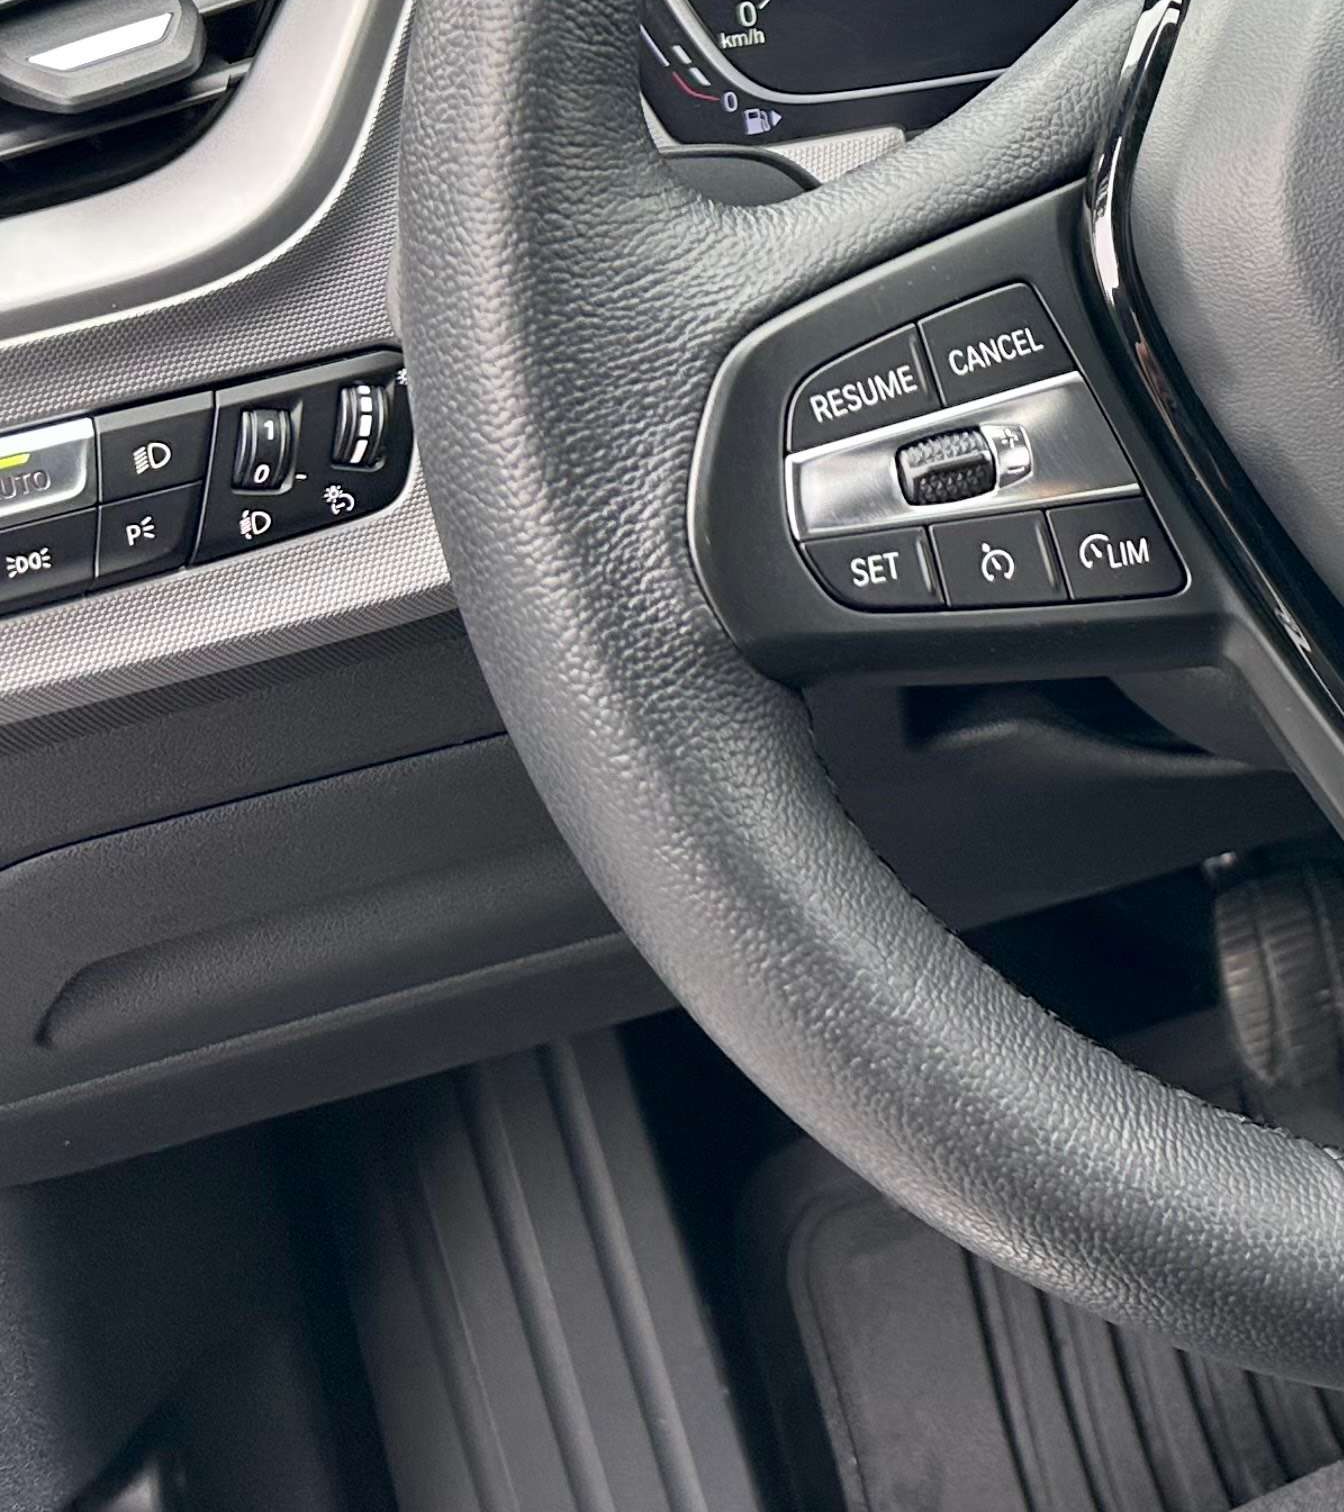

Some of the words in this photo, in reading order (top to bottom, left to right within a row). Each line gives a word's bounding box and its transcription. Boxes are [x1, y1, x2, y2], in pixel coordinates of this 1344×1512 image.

[737, 1, 758, 28] 0
[720, 29, 765, 49] km/h
[948, 327, 1044, 376] CANCEL
[810, 364, 919, 423] RESUME
[264, 420, 276, 441] 1
[0, 471, 51, 500] UTO
[254, 463, 271, 484] 0
[1107, 539, 1150, 569] LIM
[850, 552, 899, 587] SET
